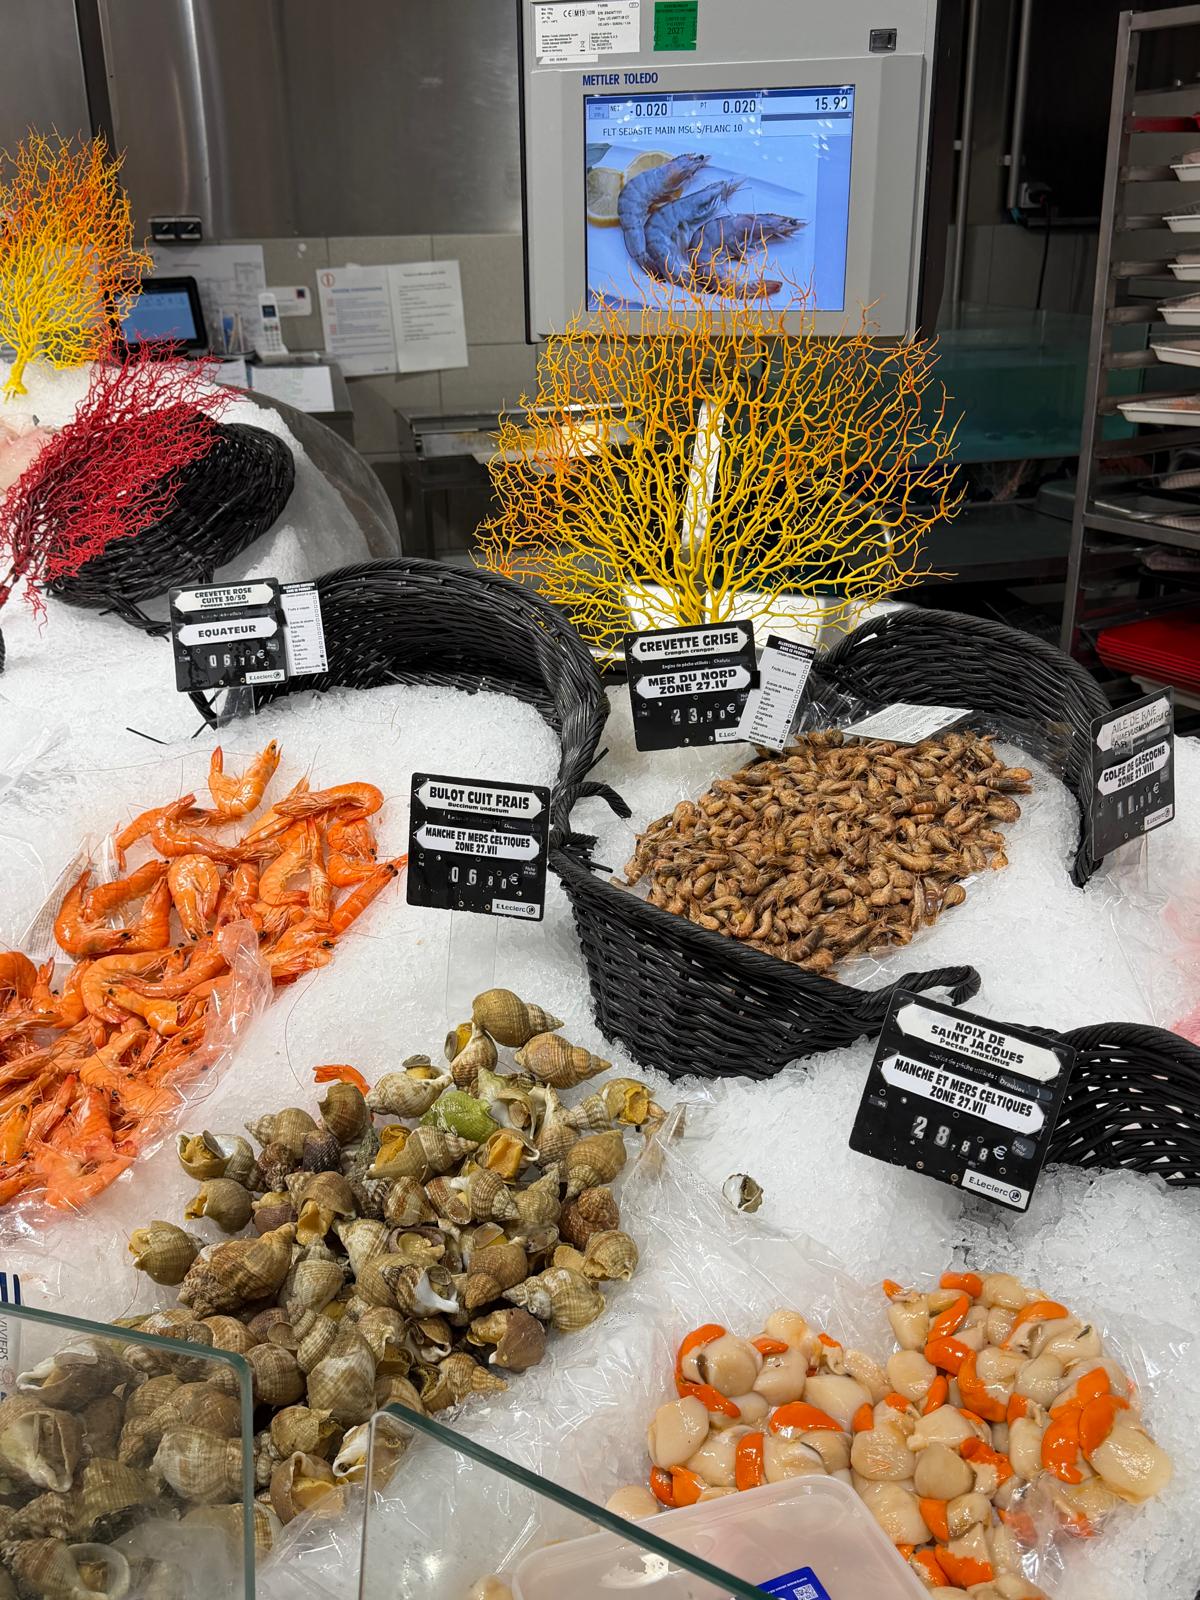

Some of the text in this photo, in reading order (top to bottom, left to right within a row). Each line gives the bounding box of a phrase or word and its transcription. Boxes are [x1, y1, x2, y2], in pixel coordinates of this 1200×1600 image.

[582, 72, 658, 86] METTLER TOLEDO
[723, 100, 756, 114] 0.020
[603, 128, 617, 136] FLT
[655, 126, 675, 134] MAIN
[734, 124, 742, 132] 10
[194, 589, 231, 598] CREVETTE
[198, 625, 256, 638] EQUATEUR
[640, 632, 739, 652] CREVETTE GRISE
[648, 669, 737, 686] MER DU NORD
[660, 680, 728, 694] ZONE 27.IV
[1104, 745, 1165, 782] GOLFE DE GASCOGNE
[1118, 772, 1134, 787] ZONE
[430, 786, 529, 810] BULOT CUIT FRAIS
[448, 802, 479, 810] Buccinum
[426, 827, 530, 848] MANCHE ET MERS CELTIQUES
[455, 842, 498, 855] ZONE 27.VII
[954, 1022, 1005, 1047] NOIX DE
[931, 1025, 1024, 1064] SAINT JACQUES
[940, 1037, 1010, 1067] Pecten maximus
[894, 1058, 1033, 1117] MANCHE ET MERS CELTIQUES
[930, 1086, 987, 1116] ZONE 27.VII
[968, 1176, 1009, 1196] E.Leclerc
